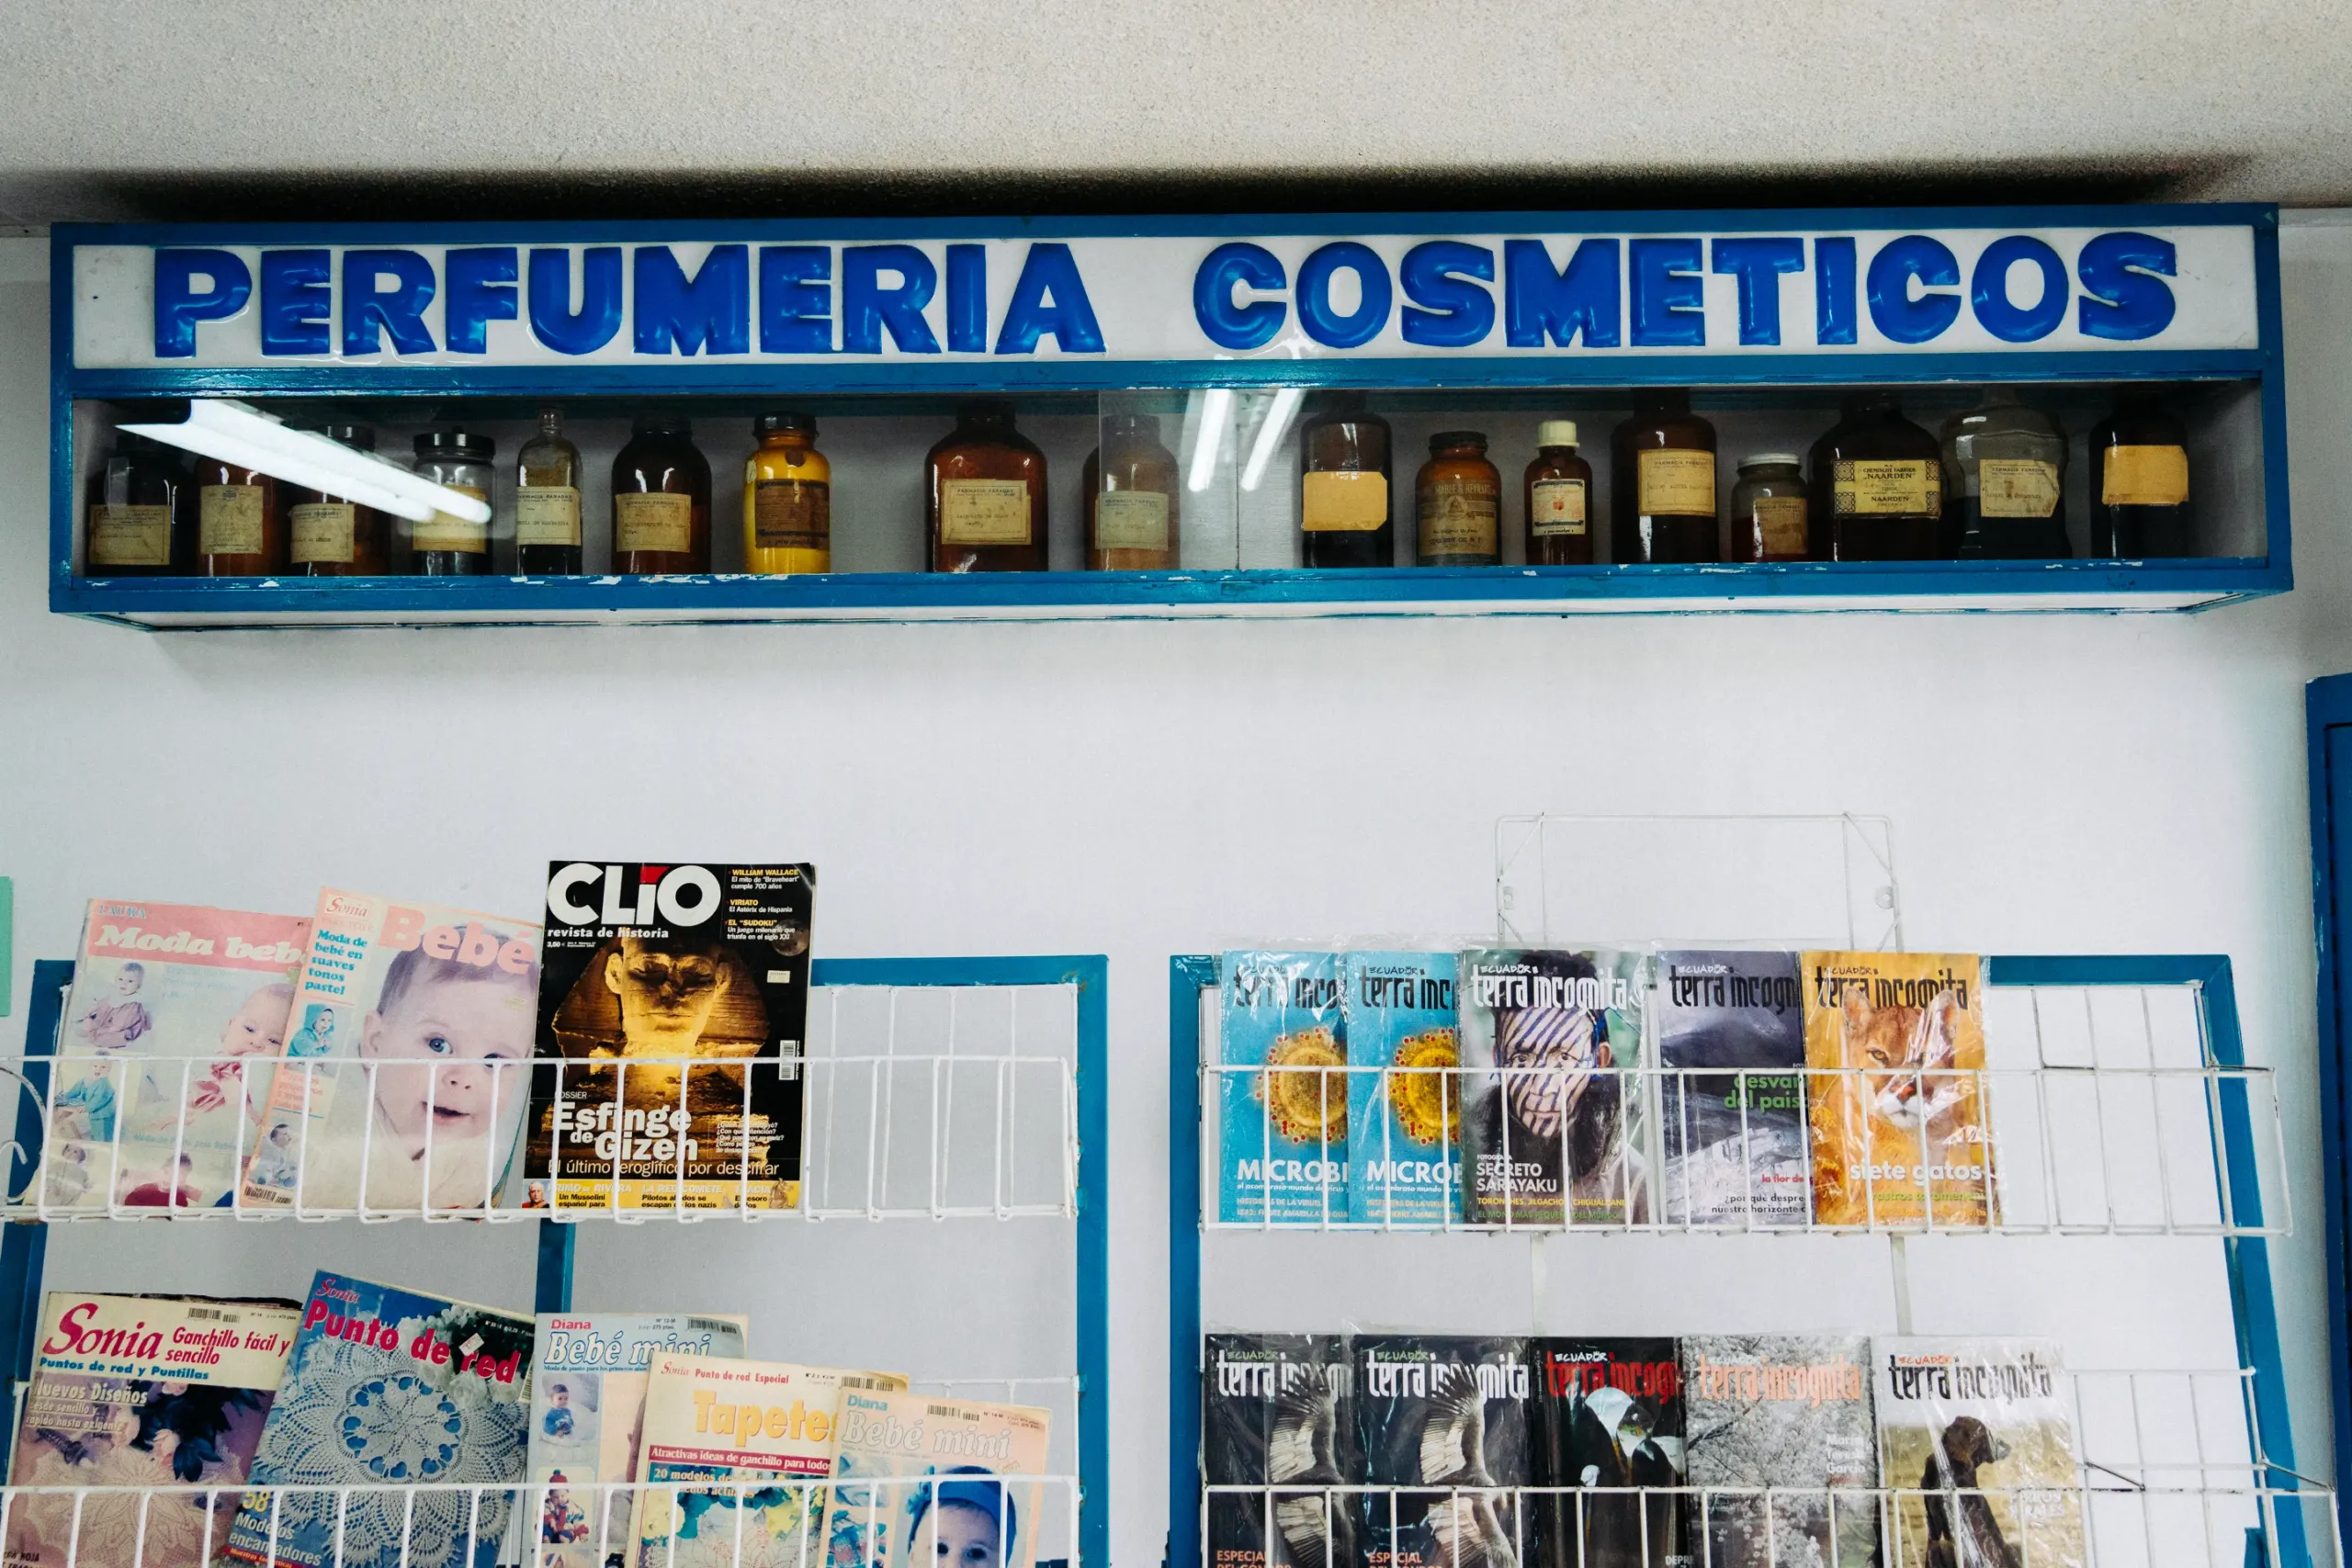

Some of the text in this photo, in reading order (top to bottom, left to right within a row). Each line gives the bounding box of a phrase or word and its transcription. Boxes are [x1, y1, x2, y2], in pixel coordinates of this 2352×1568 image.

[154, 232, 2177, 358] PERFUMERIA COSMETICOS
[326, 896, 368, 918] Sonia
[95, 924, 215, 956] Moda
[317, 930, 368, 948] Moda de
[377, 905, 536, 975] Bebé
[548, 926, 669, 938] revista de historia
[314, 942, 364, 960] bebé en
[311, 955, 356, 971] suaves
[1369, 965, 1419, 976] ECUADOR
[1480, 964, 1532, 975] ECUADOR
[1678, 964, 1729, 975] ECUADOR
[308, 967, 345, 982] tonos
[304, 980, 345, 996] pastel
[1360, 965, 1415, 1009] terra
[1471, 964, 1628, 1017] terra incognita
[1669, 964, 1726, 1008] terra
[1815, 965, 1969, 1010] terra incognita
[570, 1129, 594, 1144] de
[566, 1158, 780, 1177] último por descifrar
[1476, 1162, 1543, 1177] SECRETO
[1912, 1160, 1983, 1187] gatos
[1476, 1178, 1557, 1193] SARAYAKU
[1761, 1173, 1804, 1183] la flor de
[559, 1201, 587, 1209] español
[1751, 1204, 1798, 1213] horizonte
[315, 1278, 360, 1304] Sonia
[42, 1302, 164, 1360] Sonia
[550, 1318, 592, 1330] Diana
[172, 1325, 291, 1358] Ganchillo fácil y
[303, 1298, 522, 1384] Punto de red
[543, 1330, 624, 1366] Bebé
[164, 1347, 220, 1366] sencillo
[1227, 1349, 1278, 1361] ECUADOR
[1377, 1349, 1430, 1361] ECUADOR
[1555, 1350, 1608, 1362] ECUADOR
[40, 1356, 210, 1381] Puntos de red y Puntillas
[662, 1360, 790, 1384] Sonia Punto de red Especial
[1216, 1349, 1279, 1398] terra
[1366, 1349, 1426, 1398] terra
[1545, 1350, 1606, 1398] terra
[1888, 1351, 2052, 1405] terra incognita
[1699, 1353, 1861, 1408] terra incognita
[92, 1382, 149, 1404] Diseños
[846, 1393, 888, 1412] Diana
[57, 1402, 90, 1415] sencillo
[56, 1416, 81, 1428] hasta
[842, 1409, 1012, 1461] Bebé mini
[650, 1447, 698, 1461] Atractivas
[699, 1450, 725, 1462] ideas
[726, 1451, 739, 1463] de
[740, 1454, 782, 1470] ganchillo
[784, 1459, 805, 1472] para
[653, 1468, 669, 1480] 20
[671, 1469, 715, 1482] modelos
[242, 1490, 271, 1514] 58
[235, 1511, 296, 1540] Modeos
[1369, 1551, 1423, 1563] ESPCIAL
